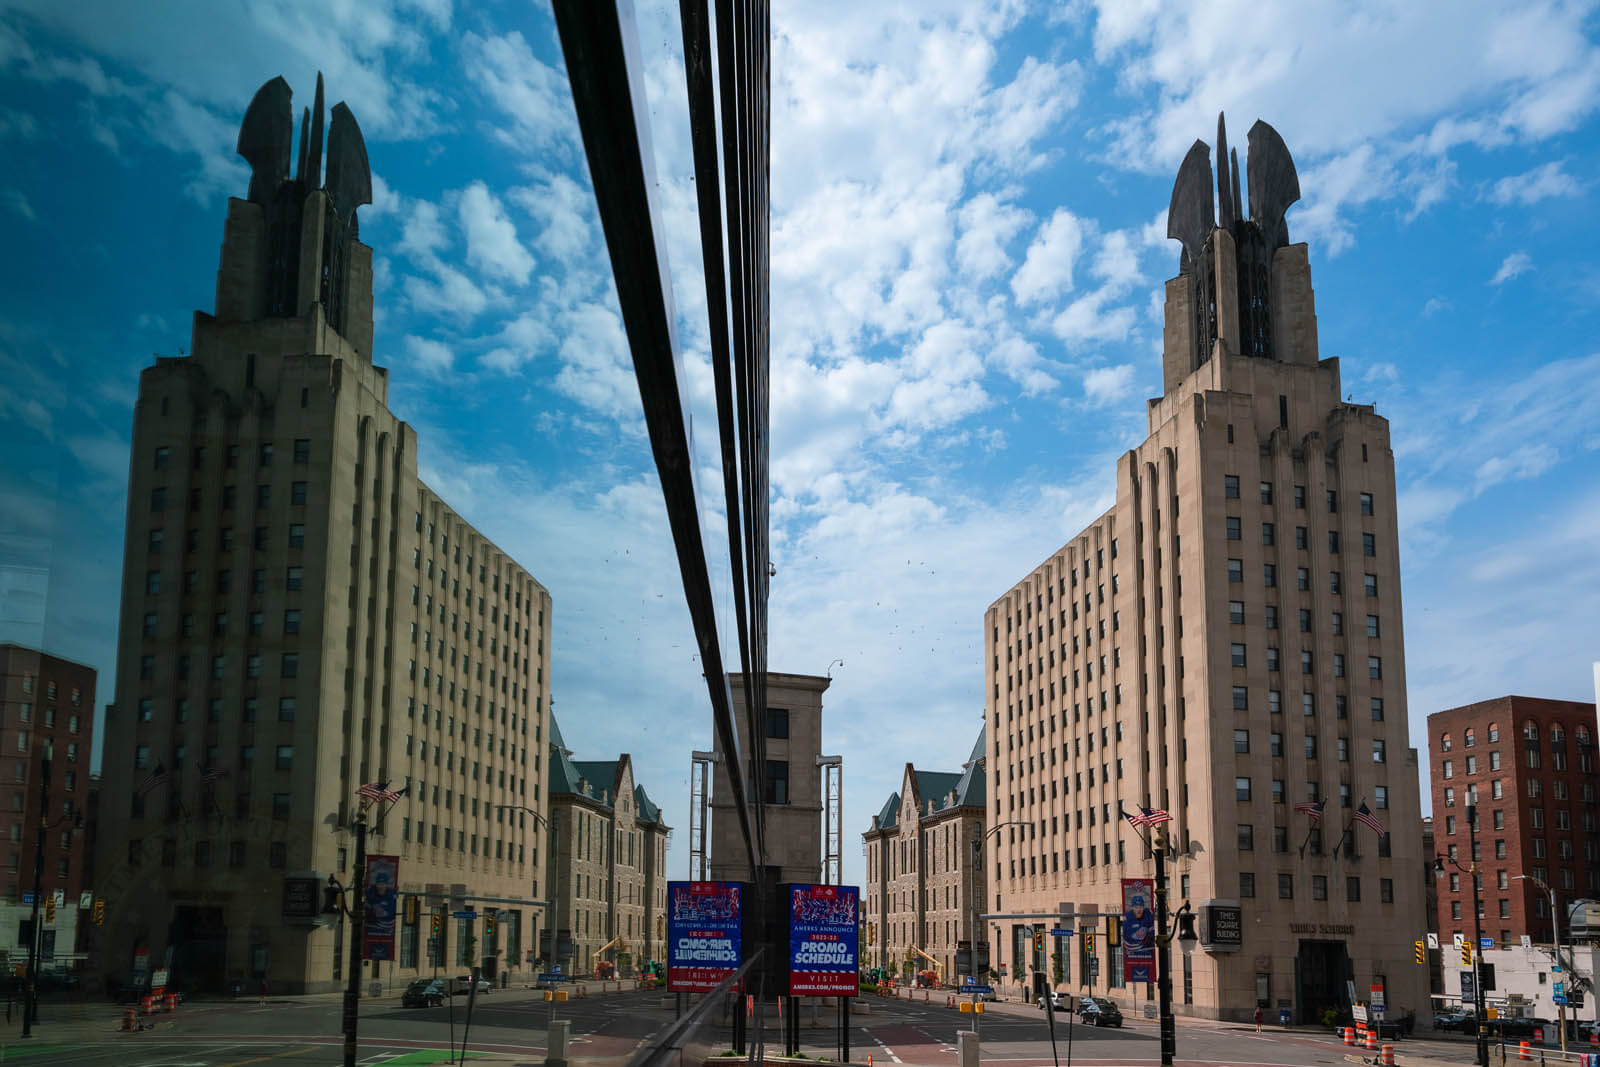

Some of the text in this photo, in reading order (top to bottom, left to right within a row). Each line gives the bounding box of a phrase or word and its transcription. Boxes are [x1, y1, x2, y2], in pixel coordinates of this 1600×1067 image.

[1219, 911, 1236, 920] TIMES
[1216, 920, 1240, 929] SQUARE
[1216, 929, 1240, 938] BUILDING
[800, 942, 848, 953] PROMO
[794, 953, 854, 965] SCHEDULE
